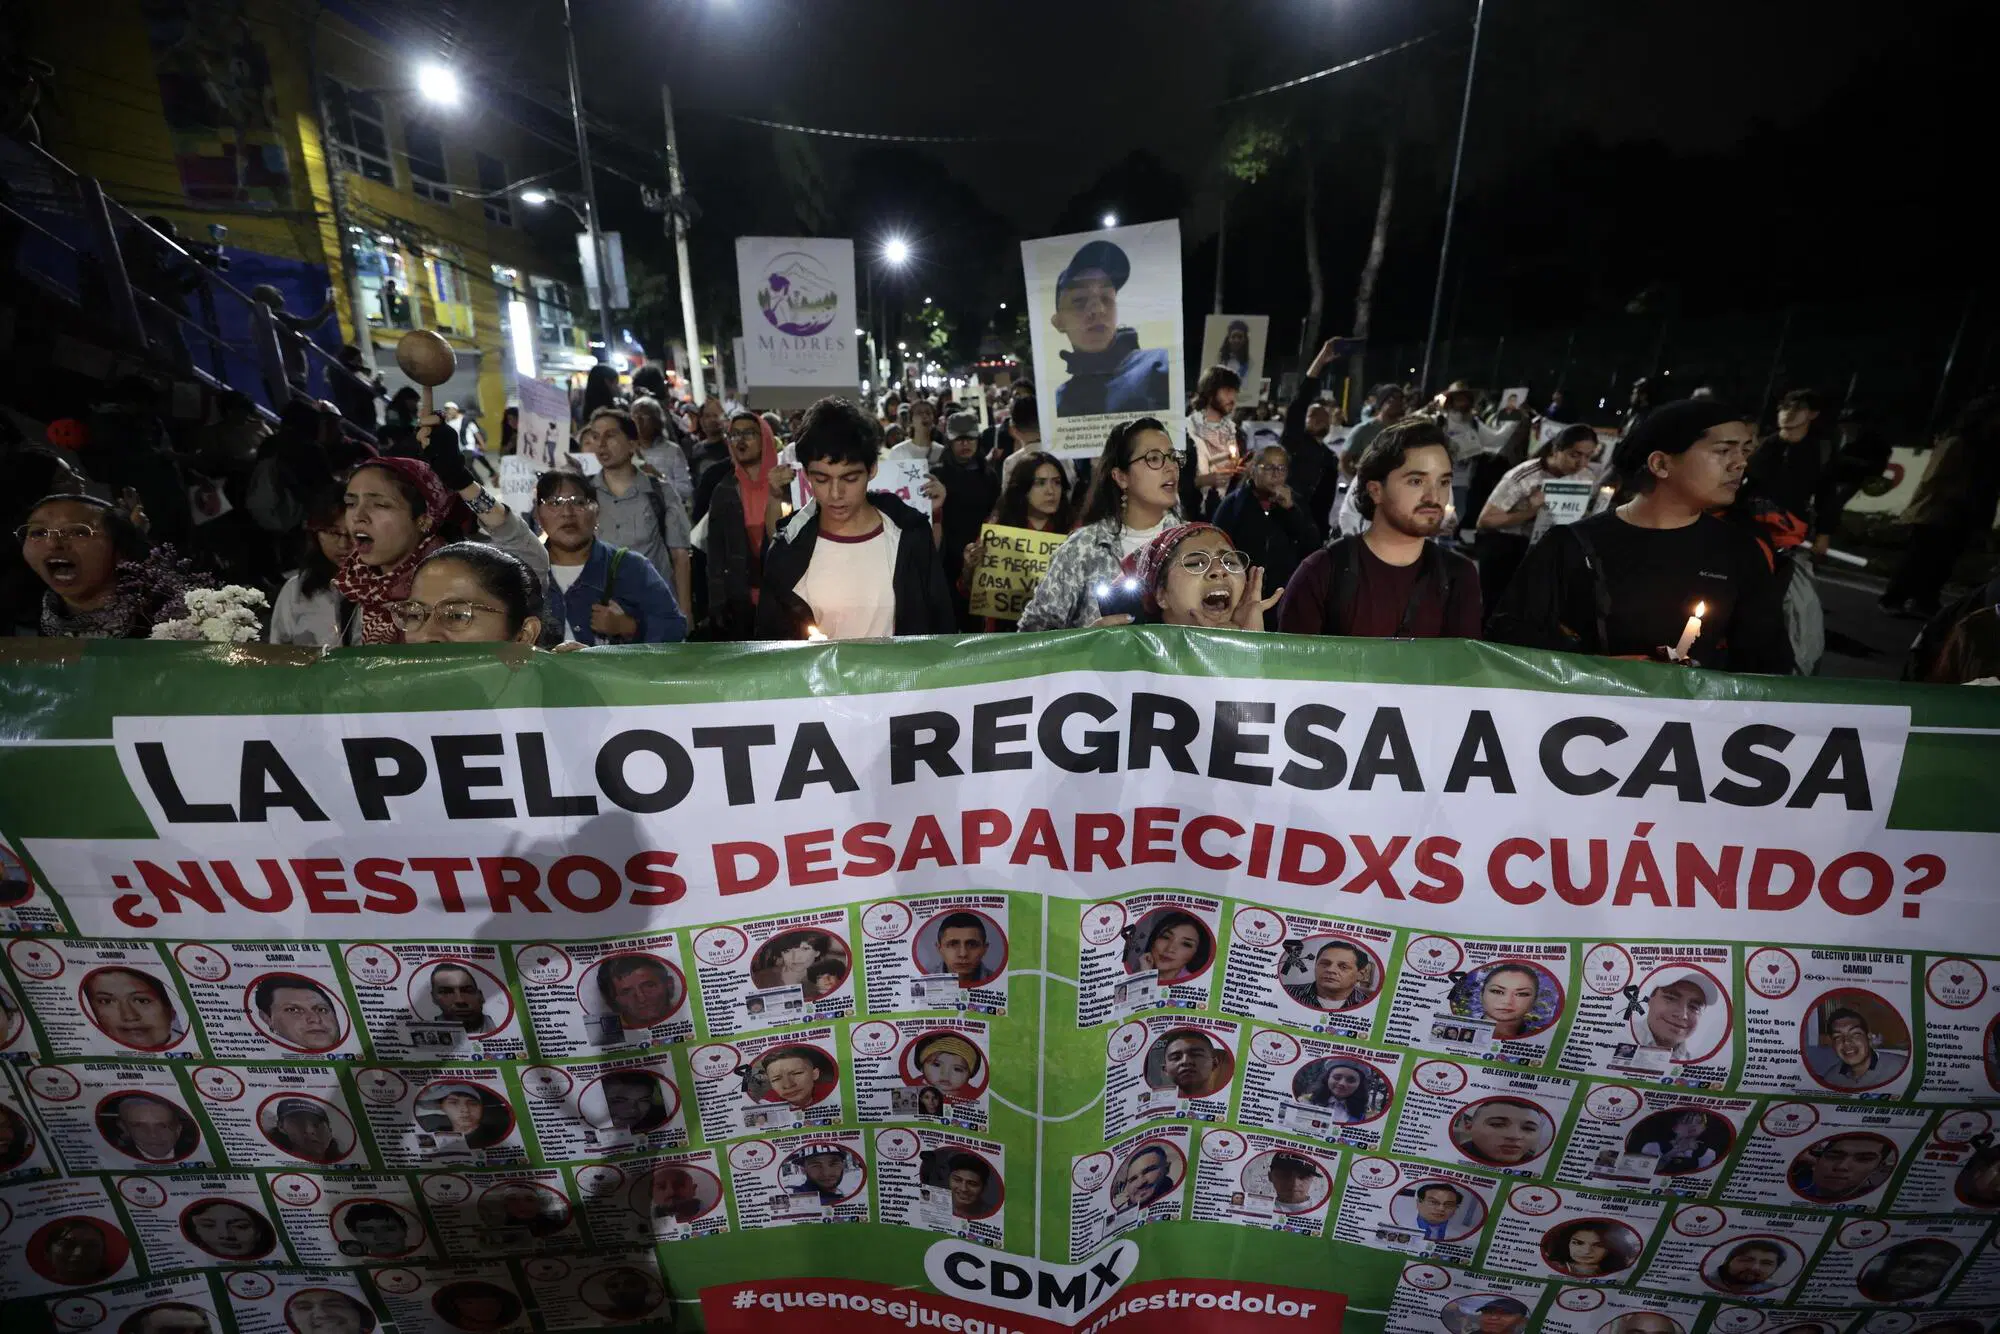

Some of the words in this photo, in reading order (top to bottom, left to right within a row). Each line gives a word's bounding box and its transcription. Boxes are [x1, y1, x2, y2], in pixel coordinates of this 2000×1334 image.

[758, 335, 846, 351] MADRES
[983, 530, 1011, 550] POR
[1016, 539, 1034, 553] EL
[981, 555, 998, 568] DE
[1001, 557, 1051, 576] REGRE
[979, 572, 1011, 589] CASA
[135, 739, 331, 823] LA
[342, 722, 860, 821] PELOTA
[889, 691, 1424, 792] REGRESA
[1444, 710, 1518, 794] A
[1539, 715, 1873, 811] CASA
[112, 849, 687, 930] ¿NUESTROS
[711, 806, 1463, 905] DESAPARECIDXS
[1487, 822, 1947, 919] CUÁNDO?
[1126, 895, 1152, 905] COLECTIVO
[1195, 897, 1218, 907] CAMINO
[743, 921, 775, 930] COLECTIVO
[777, 918, 789, 926] UNA
[820, 911, 844, 919] CAMINO
[1286, 915, 1318, 926] COLECTIVO
[1319, 920, 1332, 928] UNA
[1365, 928, 1391, 937] CAMINO
[1231, 943, 1251, 951] Julio
[1253, 946, 1277, 956] César
[1464, 942, 1497, 950] COLECTIVO
[1499, 944, 1512, 952] UNA
[1544, 946, 1567, 954] CAMINO
[1661, 947, 1673, 955] UNA
[1695, 948, 1702, 956] EL
[266, 954, 295, 962] CAMINO
[1230, 950, 1272, 963] Cervantes
[1811, 951, 1850, 960] COLECTIVO
[1852, 952, 1867, 962] UNA
[1869, 954, 1882, 962] LUZ
[1884, 954, 1894, 963] EN
[1896, 955, 1904, 964] EL
[1229, 957, 1264, 969] Cabañas
[1843, 965, 1872, 974] CAMINO
[1226, 979, 1272, 993] Septiembre
[1223, 1001, 1249, 1009] Lázaro
[1222, 1007, 1255, 1018] Obregón
[1748, 1028, 1780, 1036] Magaña
[1954, 1024, 1980, 1032] Arturo
[1927, 1032, 1959, 1040] Castillo
[1928, 1042, 1963, 1051] Cipriano
[1482, 1067, 1519, 1078] COLECTIVO
[1520, 1072, 1535, 1081] UNA
[1537, 1074, 1550, 1082] LUZ
[1562, 1078, 1571, 1086] EL
[1509, 1081, 1538, 1090] CAMINO
[1742, 1080, 1777, 1088] Quintana
[943, 1246, 1125, 1314] CDMX
